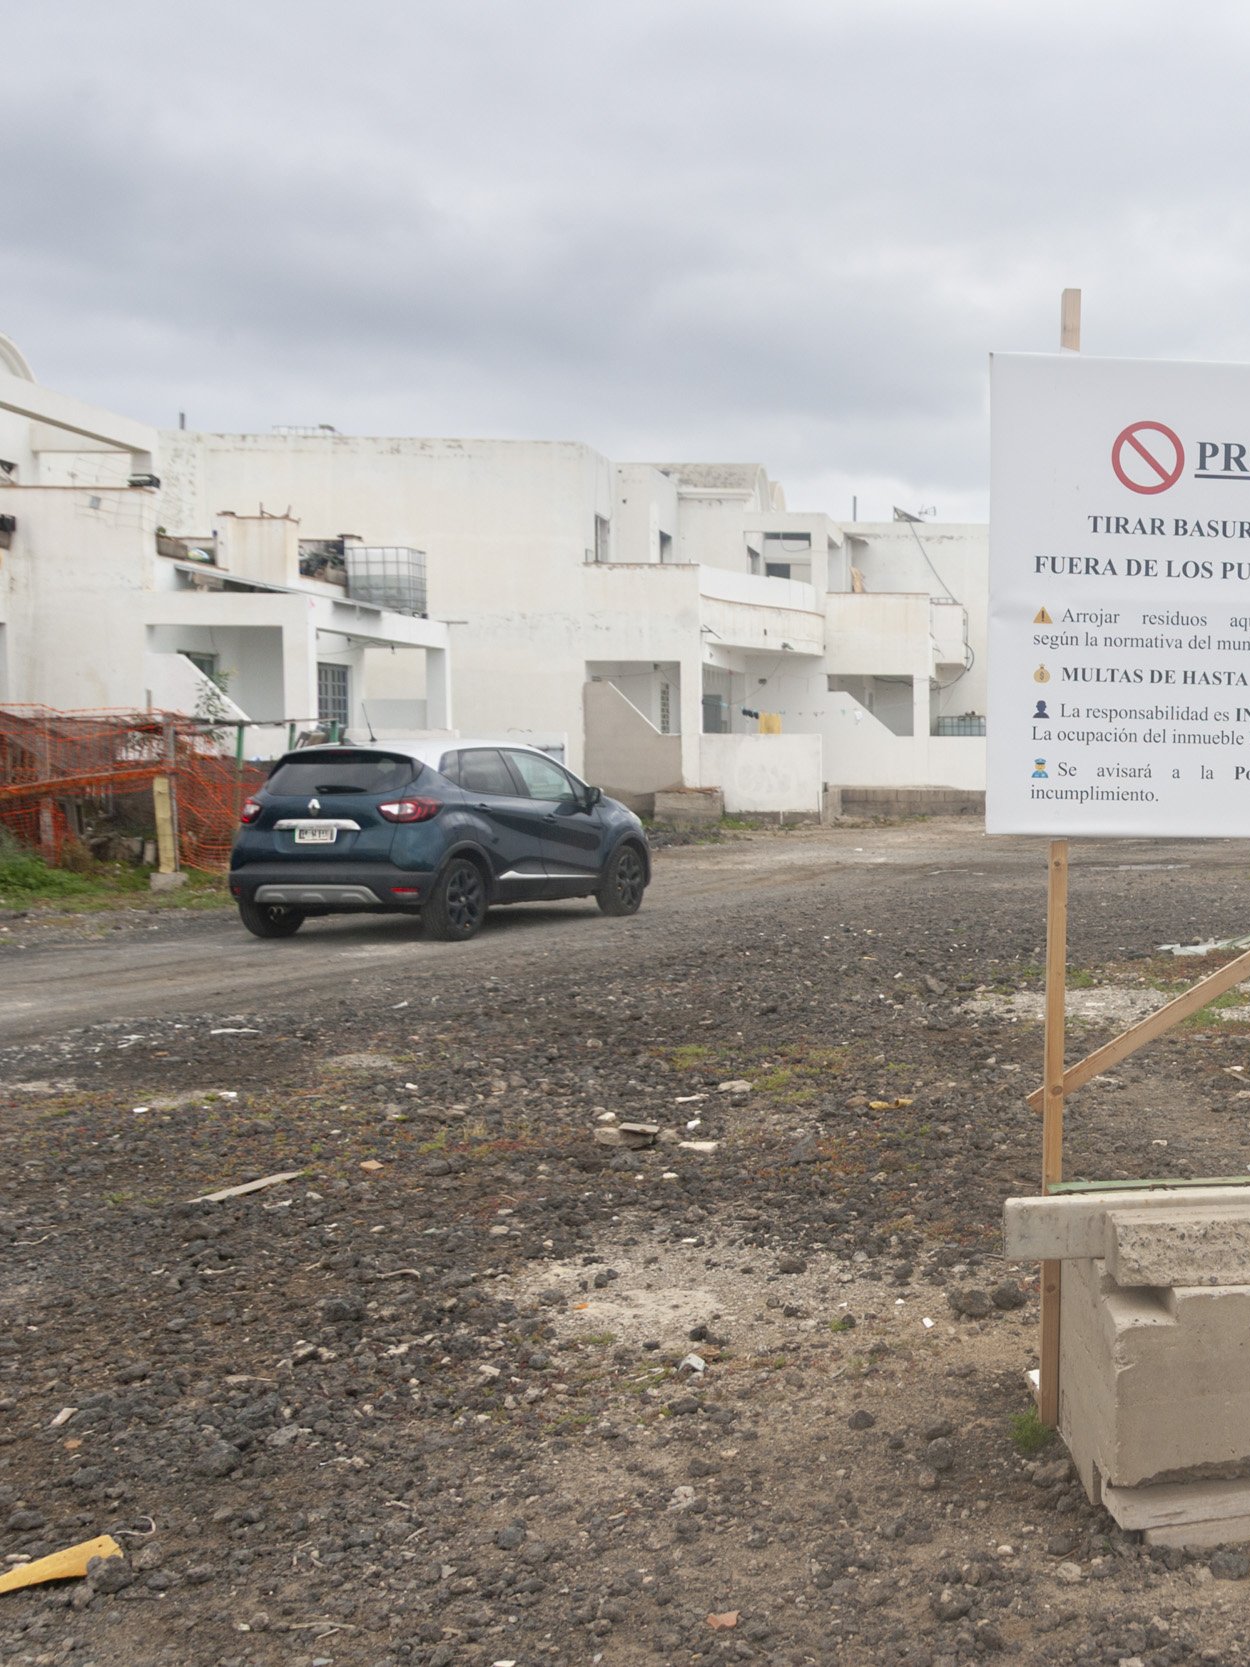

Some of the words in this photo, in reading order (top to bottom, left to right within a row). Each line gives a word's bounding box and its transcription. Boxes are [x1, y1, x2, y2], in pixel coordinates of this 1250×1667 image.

[1088, 515, 1166, 535] TIRAR
[1034, 556, 1118, 576] FUERA
[1125, 559, 1158, 577] DE
[1166, 560, 1213, 579] LOS
[1061, 608, 1120, 627] Arrojar
[1142, 610, 1207, 626] residuos
[1033, 631, 1079, 649] según
[1085, 632, 1098, 647] la
[1104, 634, 1182, 649] normativa
[1188, 635, 1211, 650] del
[1062, 667, 1143, 683] MULTAS
[1150, 670, 1176, 684] DE
[1183, 670, 1248, 686] HASTA
[1061, 703, 1080, 718] La
[1086, 705, 1208, 723] responsabilidad
[1214, 711, 1229, 721] es
[1032, 726, 1052, 740] La
[1057, 728, 1137, 745] ocupación
[1143, 728, 1166, 743] del
[1173, 729, 1244, 745] inmueble
[1058, 762, 1077, 776] Se
[1097, 763, 1152, 778] avisará
[1172, 769, 1180, 779] a
[1201, 765, 1214, 780] la
[1031, 785, 1158, 804] incumplimiento.
